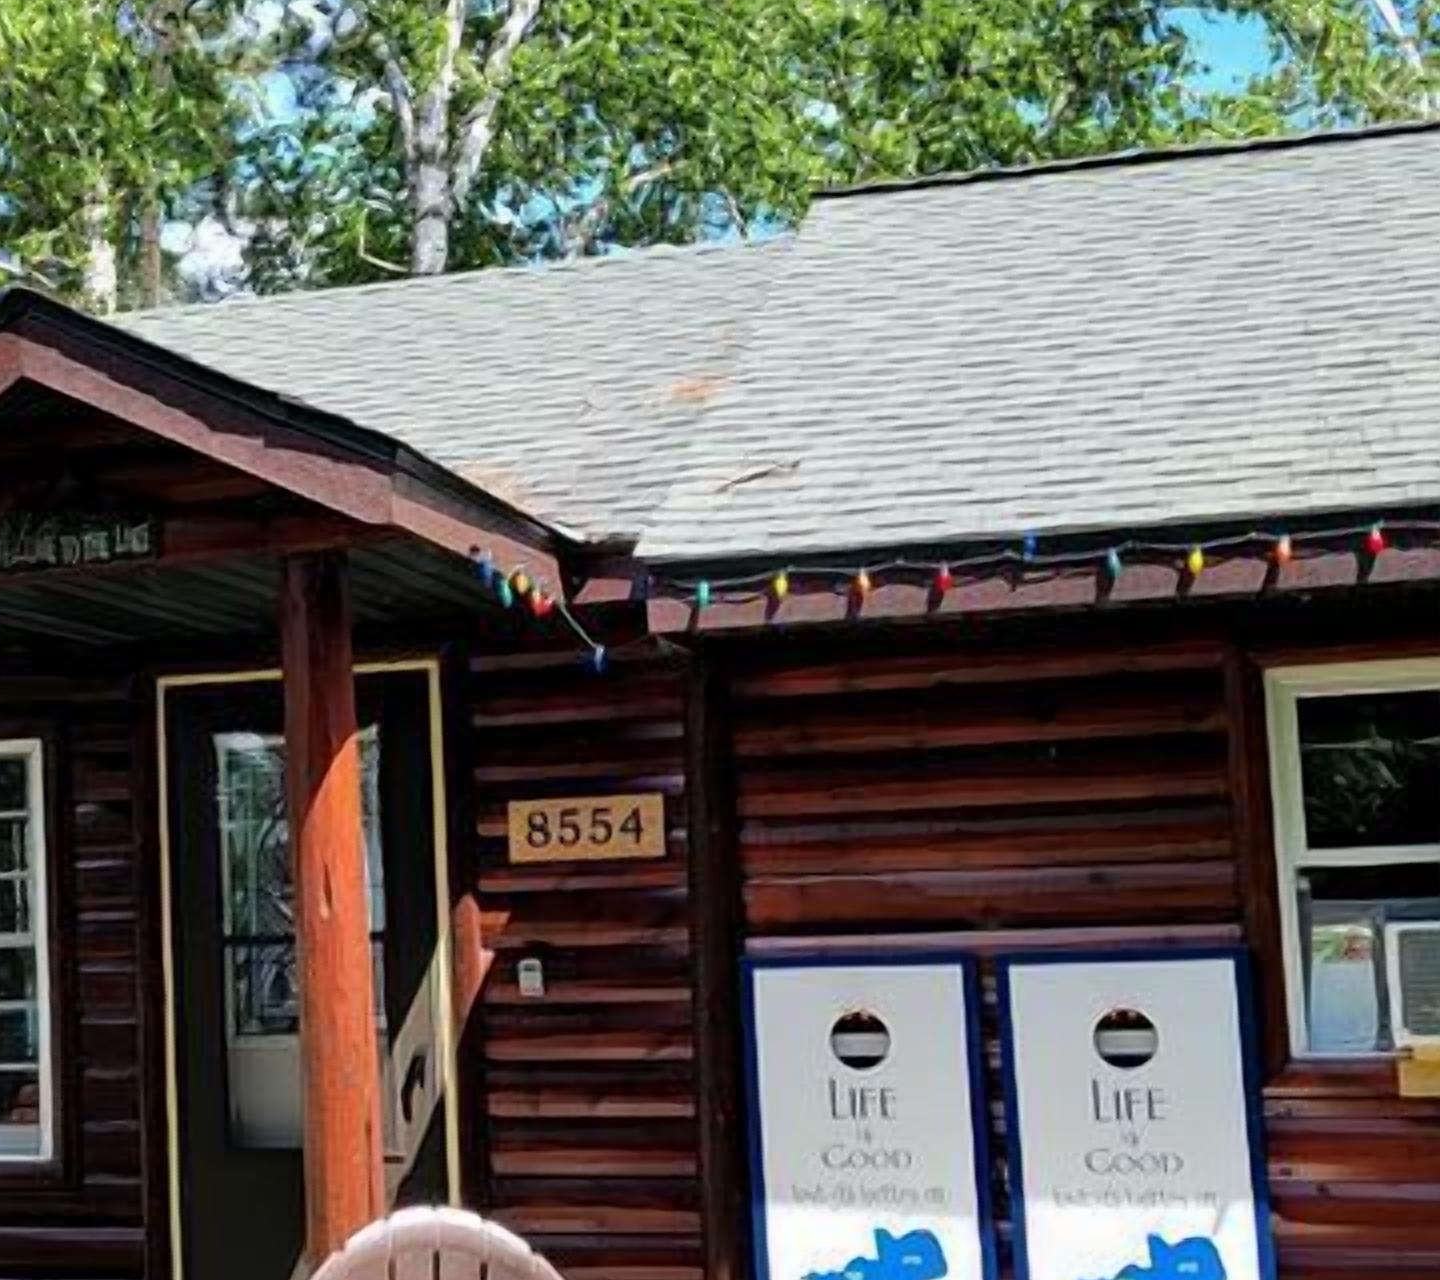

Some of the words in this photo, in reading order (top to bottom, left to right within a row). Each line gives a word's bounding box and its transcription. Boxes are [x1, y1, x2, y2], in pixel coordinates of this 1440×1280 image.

[526, 806, 644, 848] 8554
[827, 1077, 897, 1121] LIFE
[1090, 1077, 1166, 1122] LIFE
